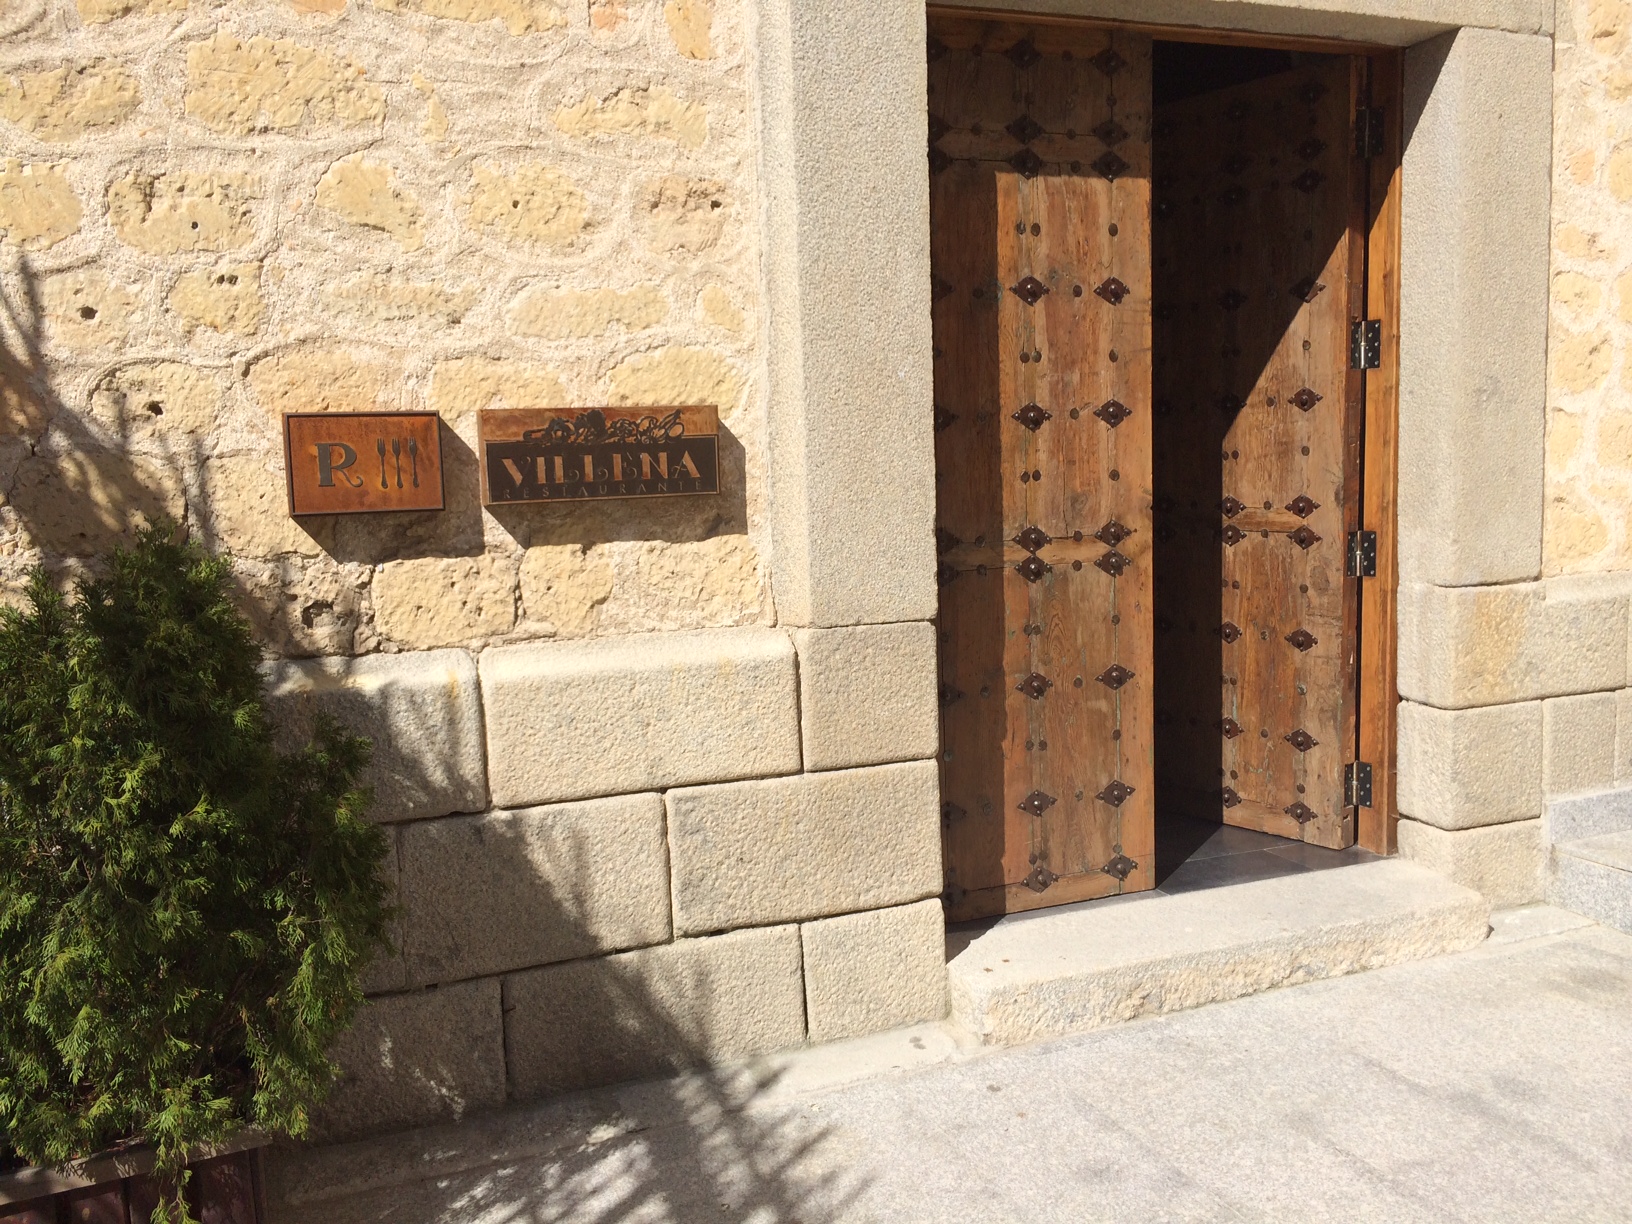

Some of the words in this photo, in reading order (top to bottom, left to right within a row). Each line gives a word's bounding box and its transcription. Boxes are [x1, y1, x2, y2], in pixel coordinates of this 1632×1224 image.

[314, 443, 363, 488] R
[500, 450, 701, 487] VILLENA
[503, 480, 702, 500] RESTAURANTE
